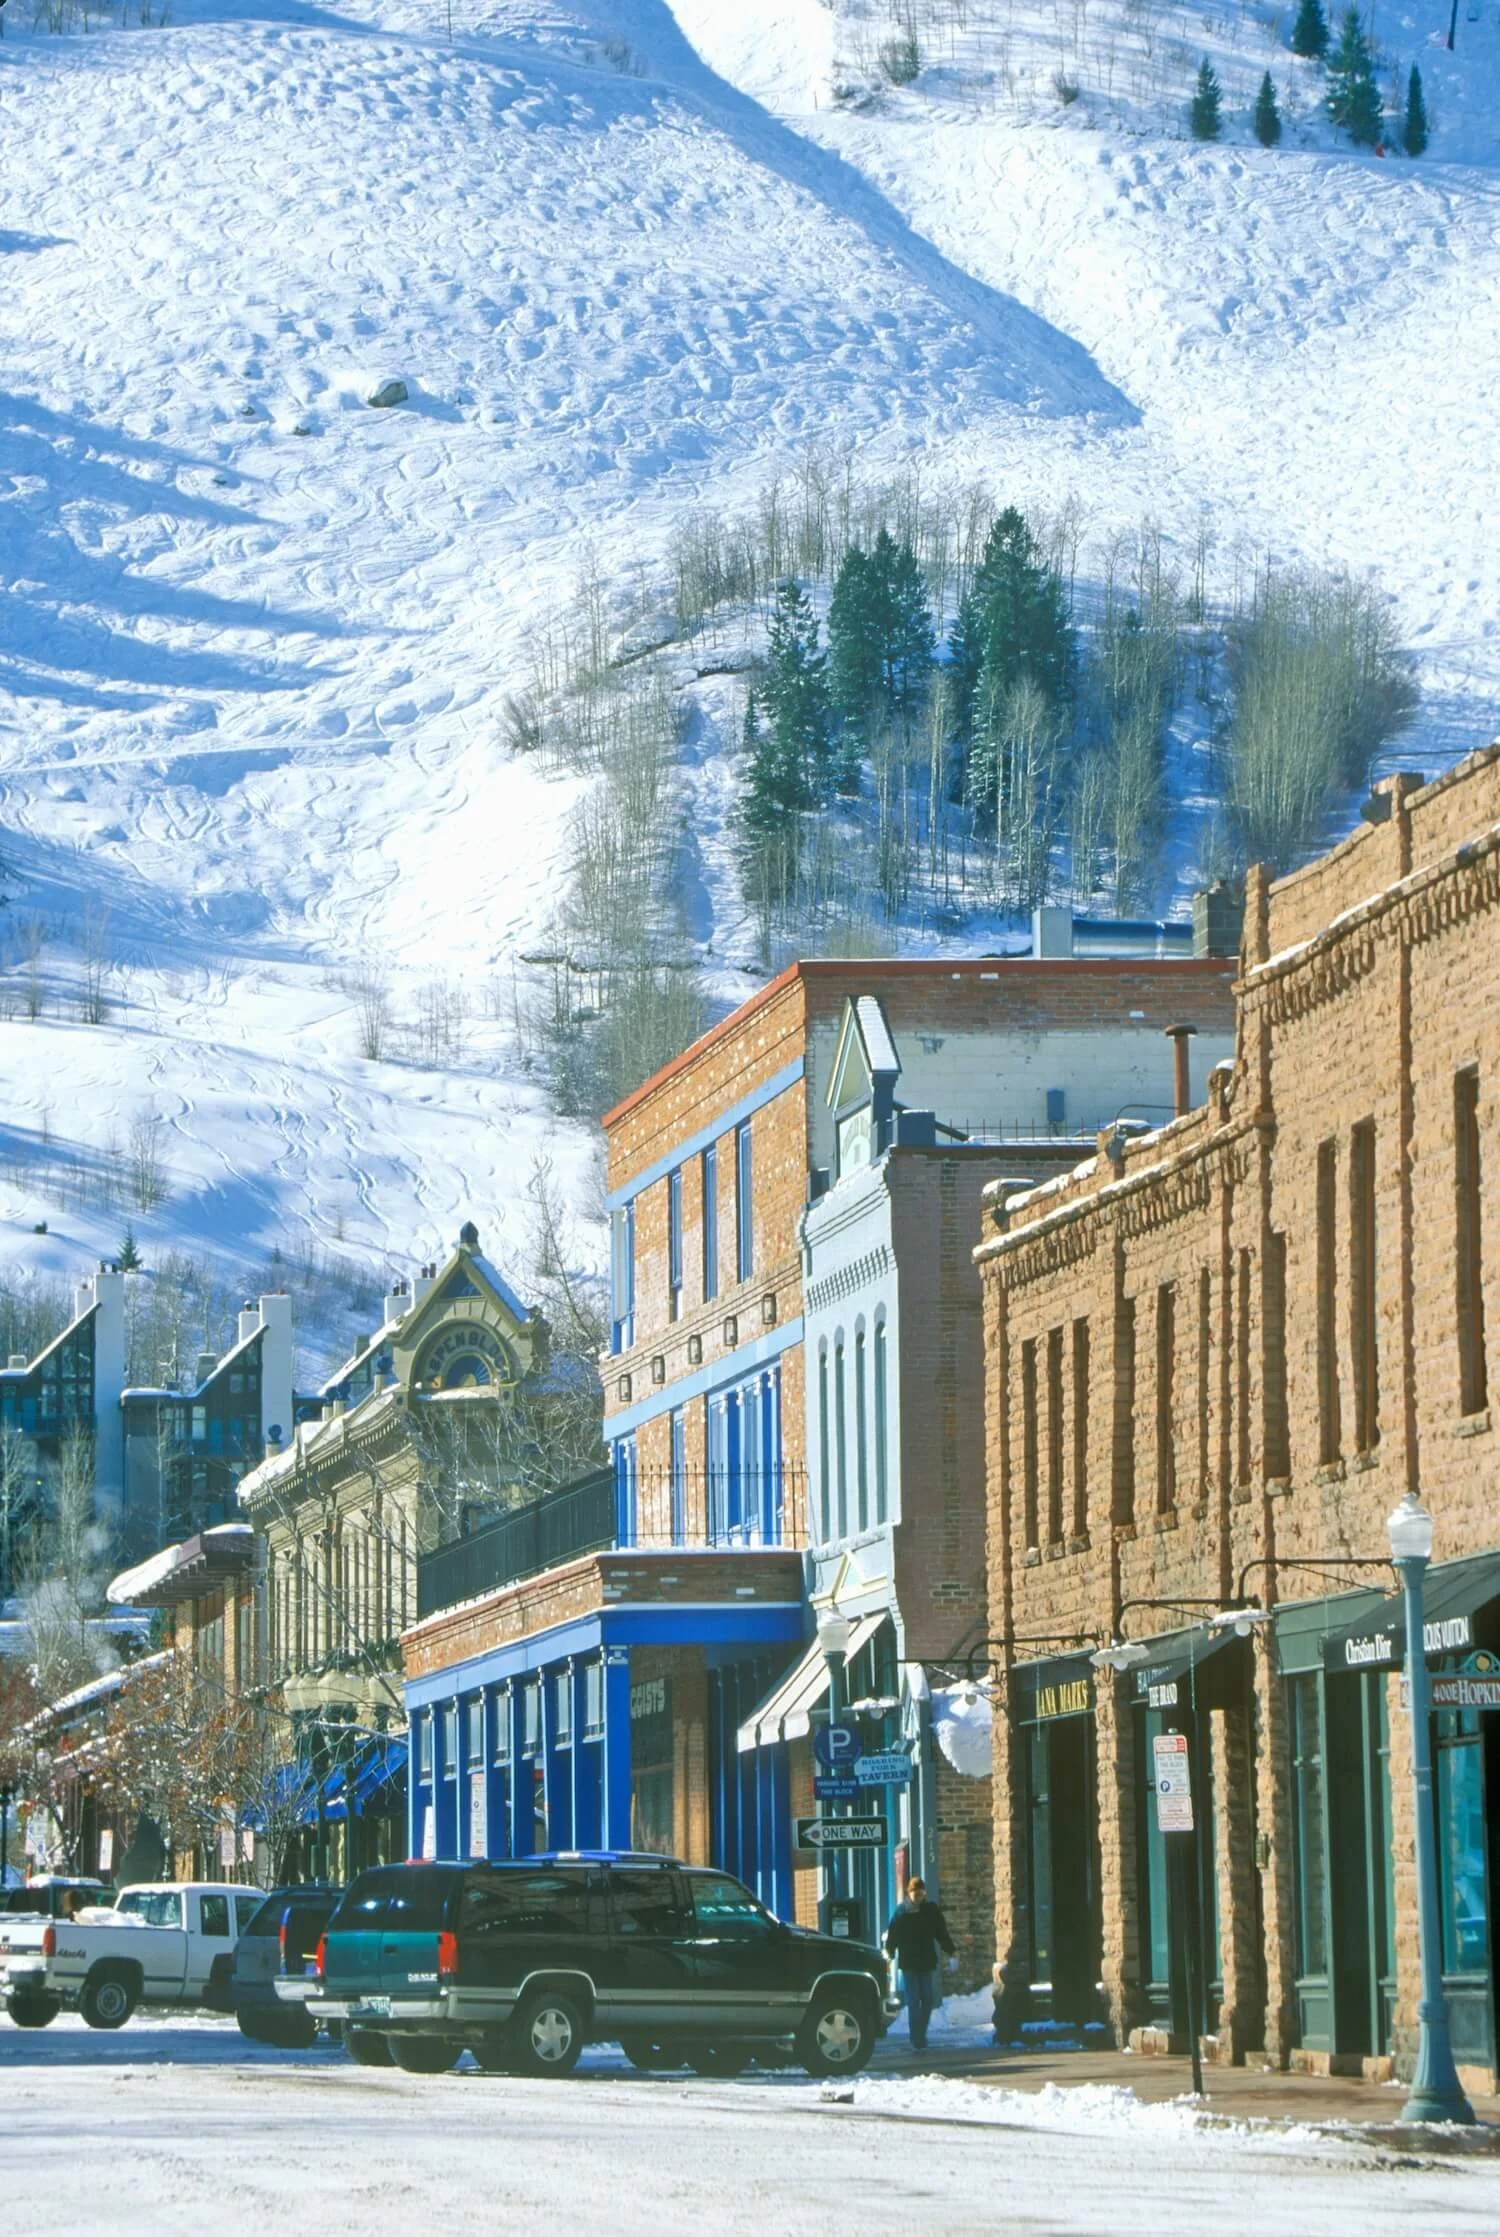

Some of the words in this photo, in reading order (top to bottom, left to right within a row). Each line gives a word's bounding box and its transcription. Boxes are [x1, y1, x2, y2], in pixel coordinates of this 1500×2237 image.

[1441, 1616, 1469, 1648] VUITTON
[1345, 1636, 1375, 1664] Christian
[1375, 1633, 1392, 1660] Dior
[1059, 1680, 1088, 1713] MARKS
[829, 1728, 851, 1760] P
[861, 1769, 909, 1781] TAVERN
[822, 1827, 847, 1839] ONE
[851, 1825, 876, 1839] WAY
